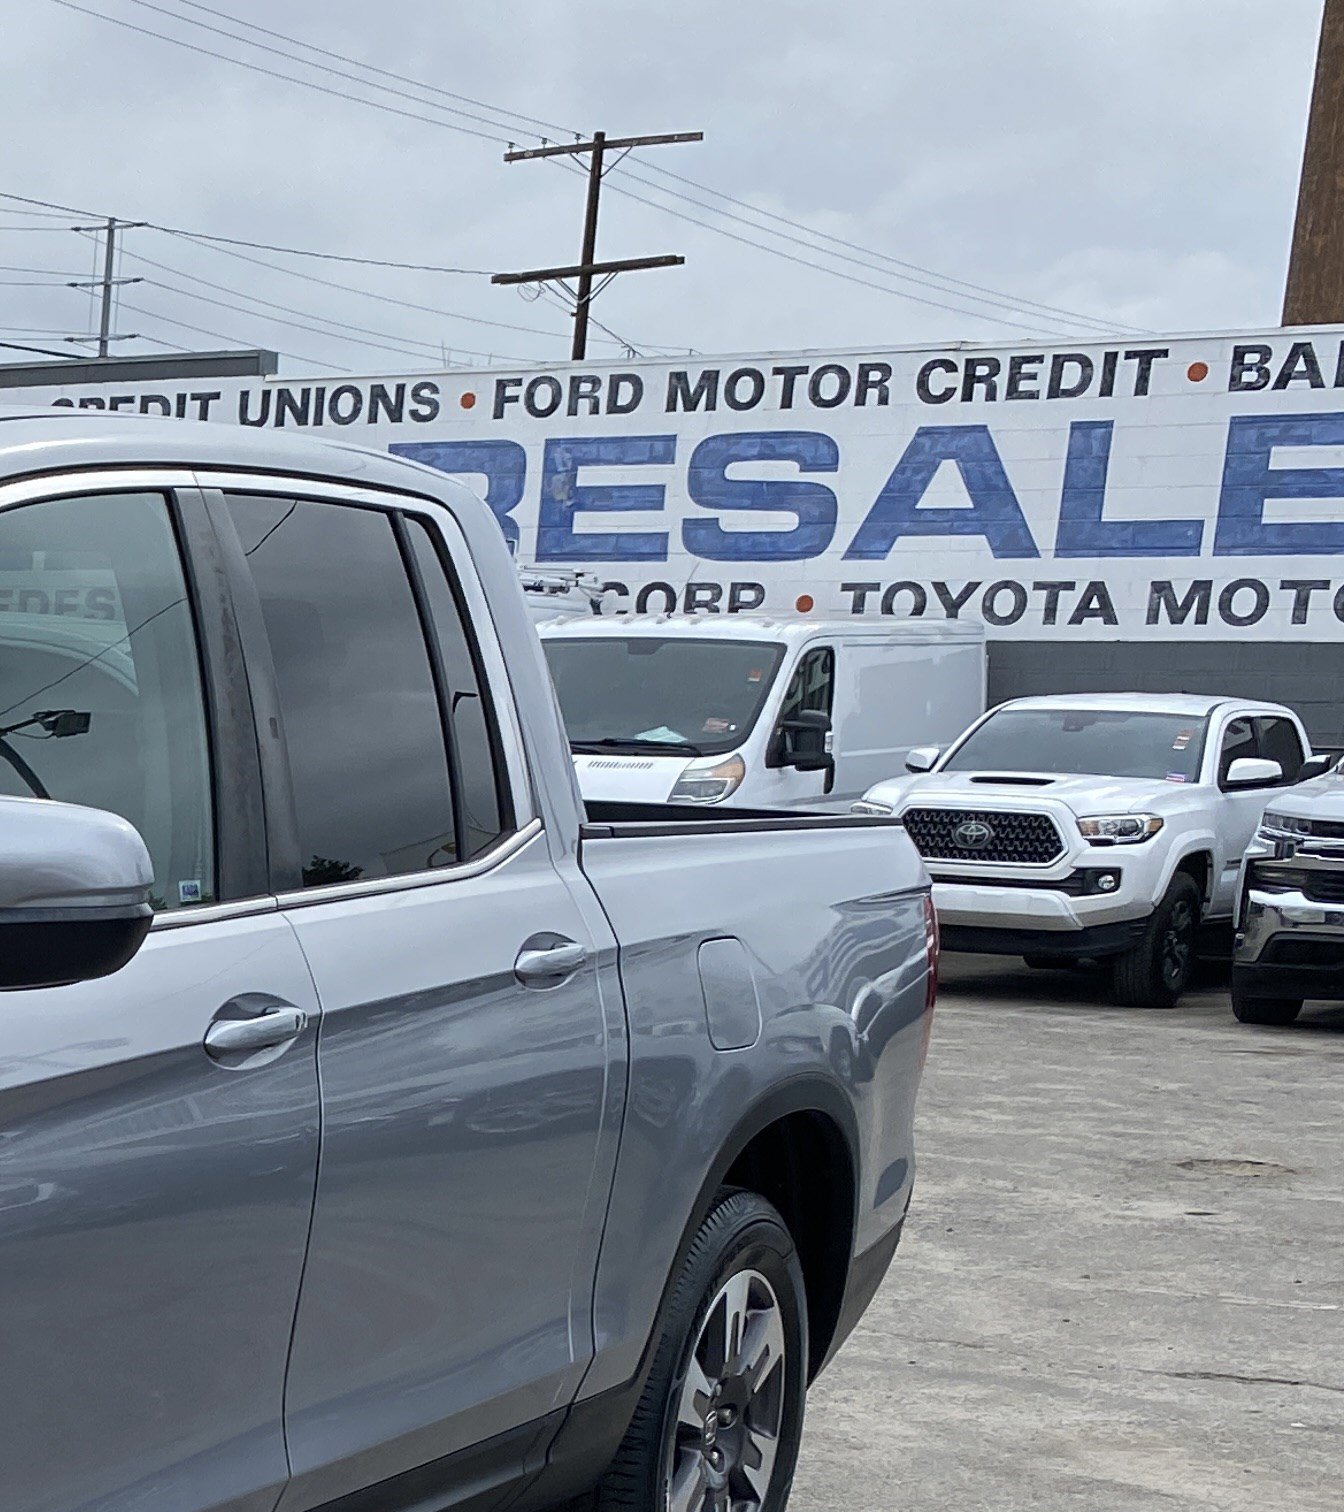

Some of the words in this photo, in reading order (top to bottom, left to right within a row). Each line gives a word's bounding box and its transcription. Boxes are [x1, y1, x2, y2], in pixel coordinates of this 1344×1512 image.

[51, 390, 221, 422] DIT
[239, 381, 440, 428] UNIONS
[492, 373, 645, 420] FORD
[664, 361, 893, 413] MOTOR
[915, 347, 1170, 404] CREDIT
[840, 578, 1120, 627] TOYOTA
